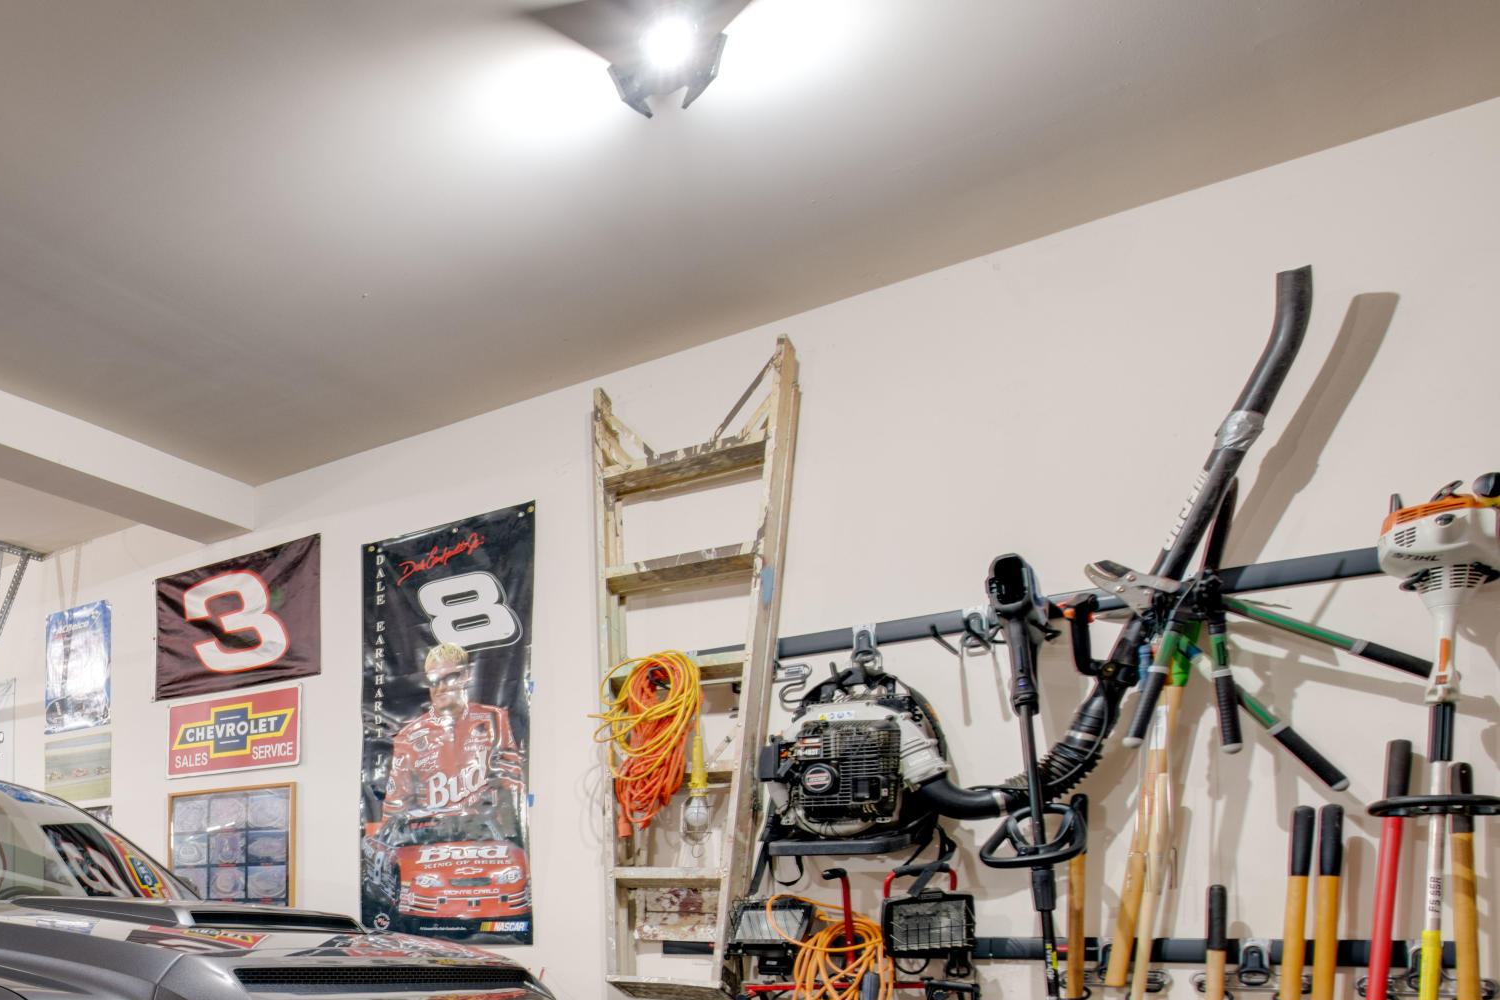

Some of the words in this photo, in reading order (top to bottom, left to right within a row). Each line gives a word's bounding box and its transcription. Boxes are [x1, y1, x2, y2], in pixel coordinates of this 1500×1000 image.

[1392, 552, 1440, 562] STIHL
[376, 554, 386, 606] DALE
[183, 569, 290, 674] 3
[417, 570, 523, 652] 8
[374, 620, 386, 739] EARNHARDT
[185, 716, 278, 742] CHEVROLET
[175, 752, 209, 769] SALES
[251, 741, 294, 760] SERVICE
[427, 749, 489, 811] Bud
[415, 845, 509, 864] Bud
[424, 861, 453, 870] KING
[493, 921, 525, 932] NASCAR
